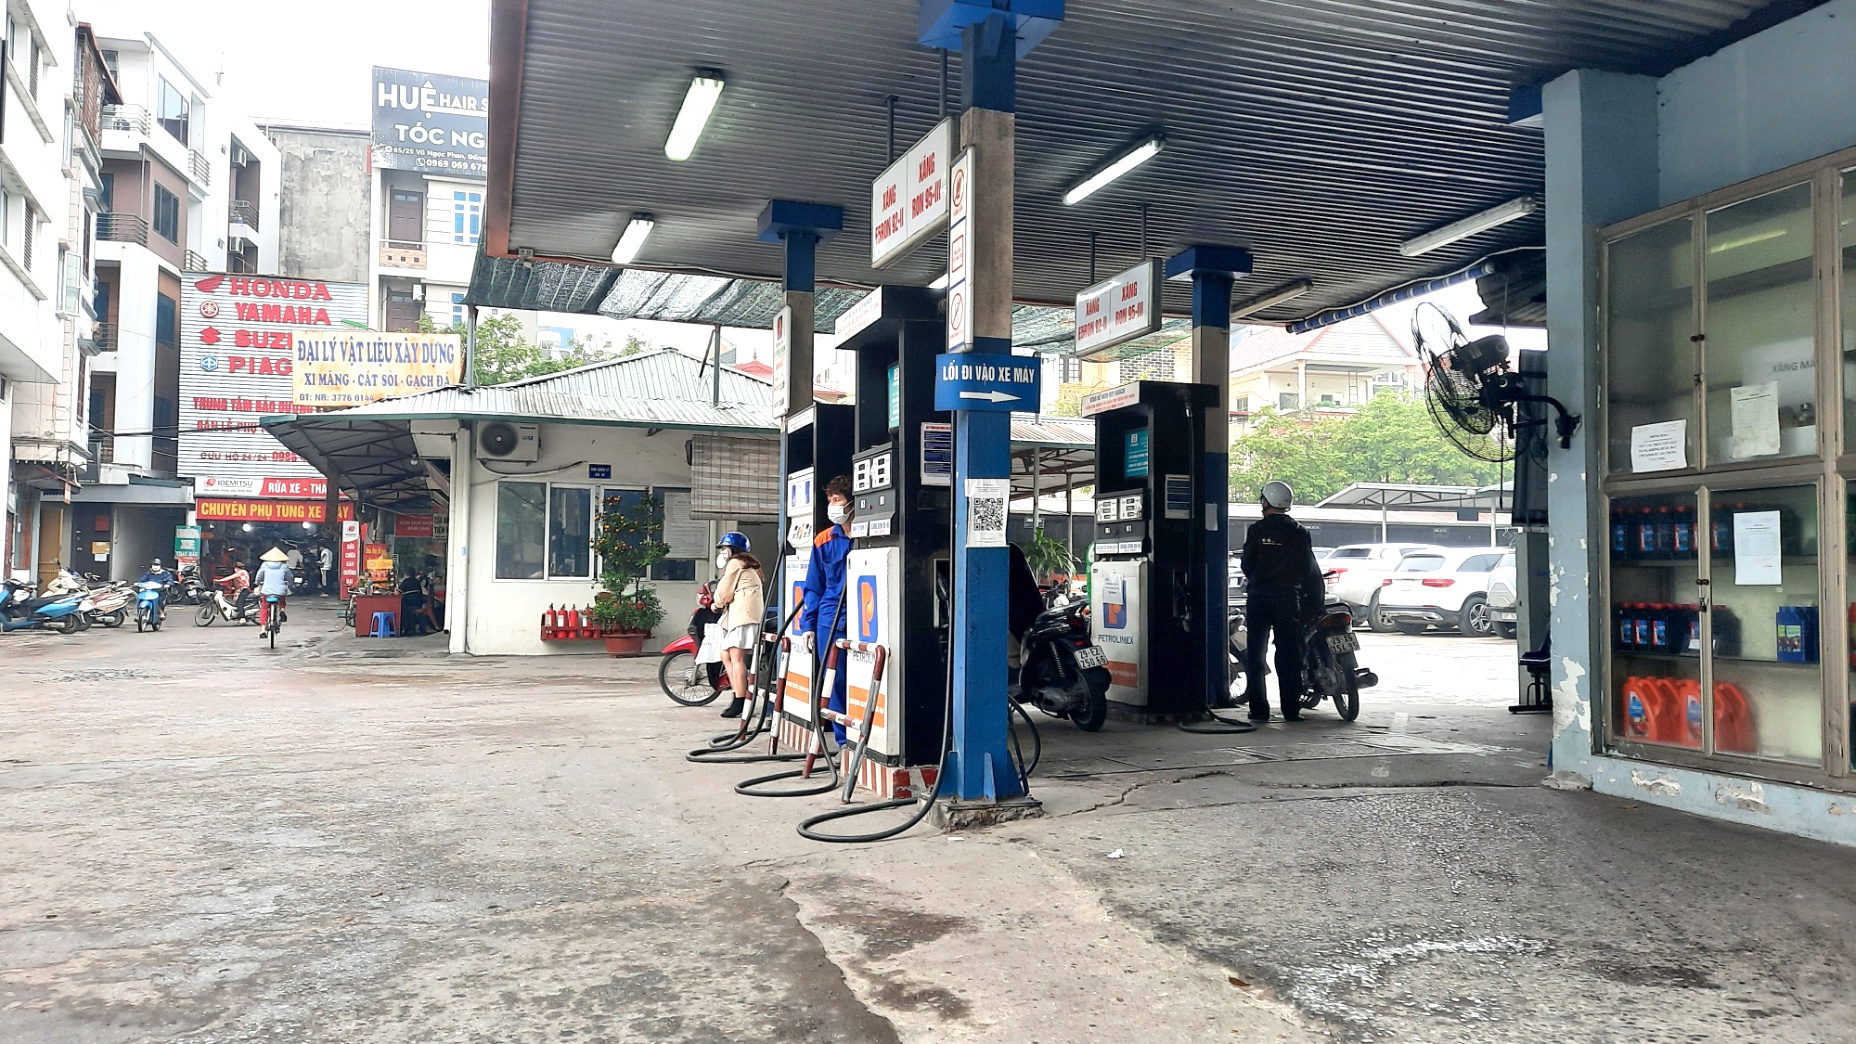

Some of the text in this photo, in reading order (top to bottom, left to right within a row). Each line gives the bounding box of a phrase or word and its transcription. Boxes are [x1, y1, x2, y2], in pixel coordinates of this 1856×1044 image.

[378, 80, 437, 119] HUỆ
[440, 93, 478, 110] HAIR
[394, 121, 488, 149] TÓC NG
[426, 159, 449, 169] 0969
[452, 161, 469, 170] 069
[427, 149, 446, 158] Ngọc
[447, 151, 466, 160] Phan,
[229, 277, 333, 301] HONDA
[235, 302, 332, 325] YAMAHA
[298, 336, 454, 368] ĐẠI LÝ VẬT LIỆU XÂY DỰNG
[228, 356, 292, 376] PIAG
[943, 359, 1035, 383] LỐI ĐI VÀO XE MÁY
[304, 373, 316, 385] XI
[319, 370, 349, 386] MĂNG
[358, 370, 378, 386] CÁT
[406, 374, 433, 390] GẠCH
[436, 372, 450, 387] ĐÁ
[268, 480, 286, 493] RỬA
[289, 482, 301, 493] XE
[310, 483, 327, 494] THA
[201, 501, 246, 516] CHUYÊN
[251, 503, 272, 519] PHỤ
[276, 502, 305, 517] TÙNG
[308, 506, 321, 518] XE
[1098, 634, 1134, 645] PETROLIMEX
